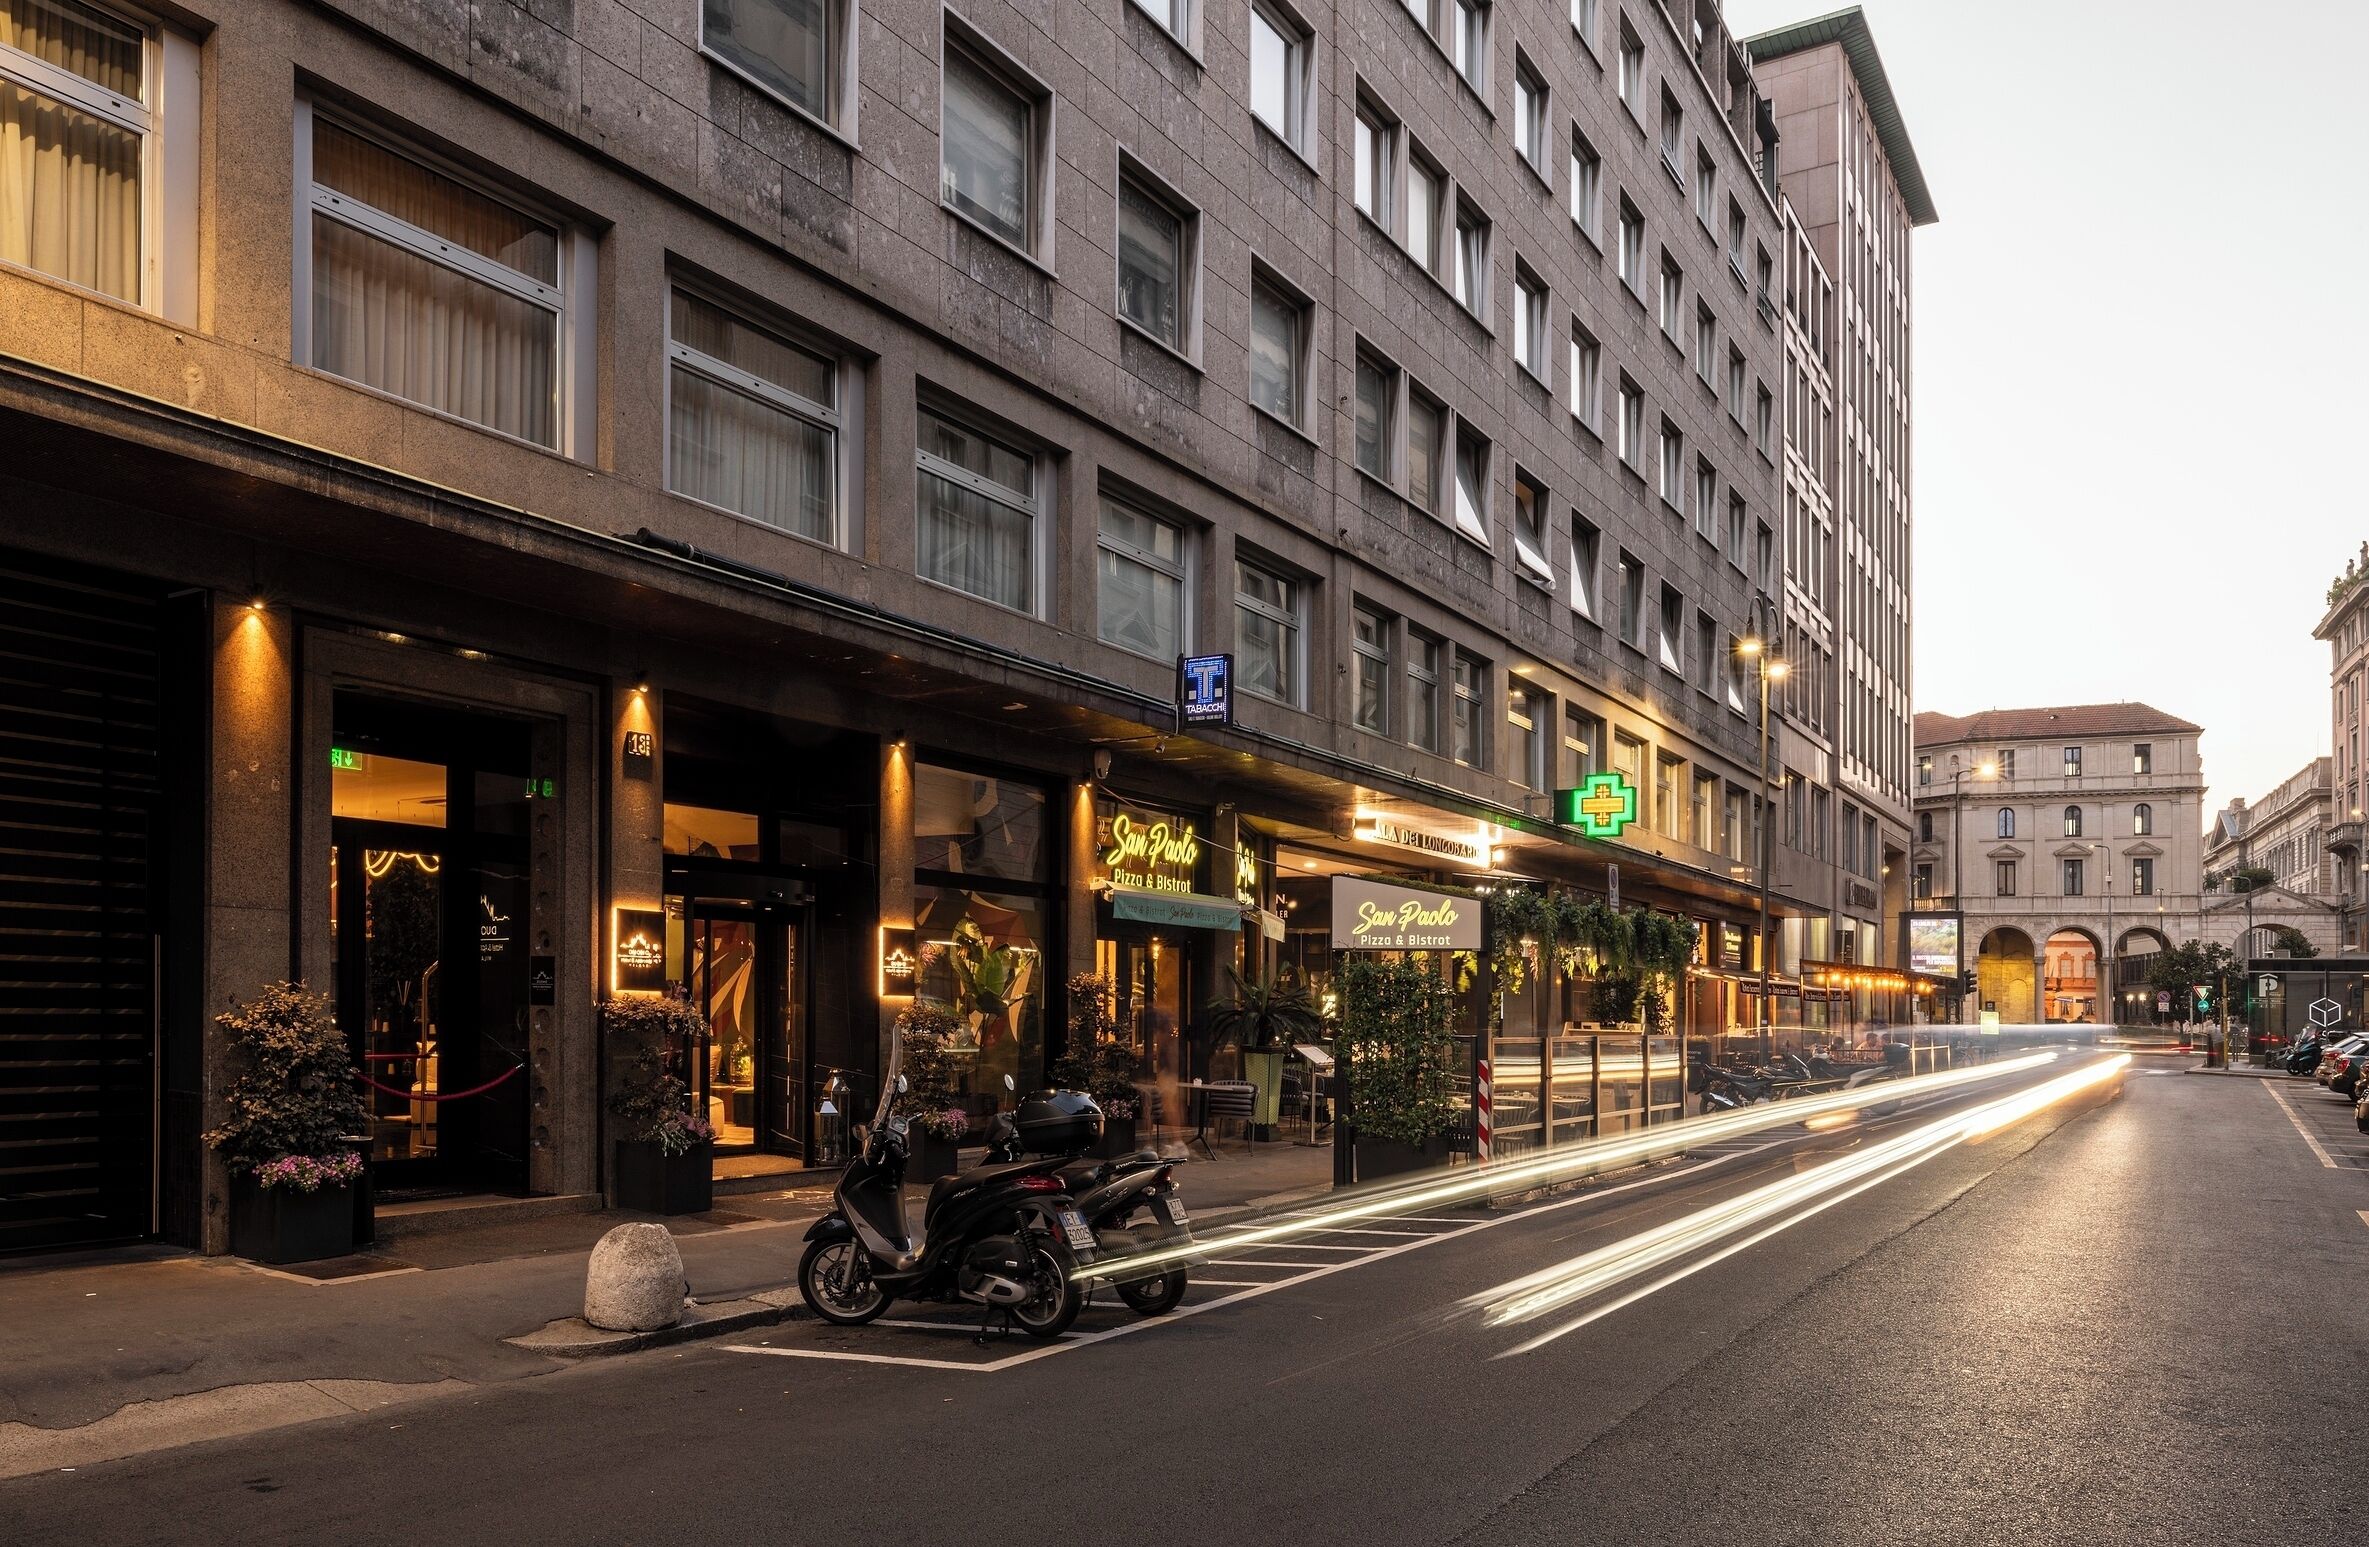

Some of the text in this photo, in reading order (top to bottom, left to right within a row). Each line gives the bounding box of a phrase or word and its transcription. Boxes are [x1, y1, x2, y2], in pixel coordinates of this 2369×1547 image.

[1185, 702, 1225, 714] TABACCHI
[1106, 814, 1198, 868] San Paolo
[1401, 829, 1419, 847] DEI
[1423, 834, 1482, 859] LONGOBARD
[1114, 868, 1191, 894] Pizza & Bistrot
[1352, 899, 1459, 935] San Paolo
[1360, 934, 1450, 946] Pizza & Bistrot
[2259, 978, 2278, 997] P
